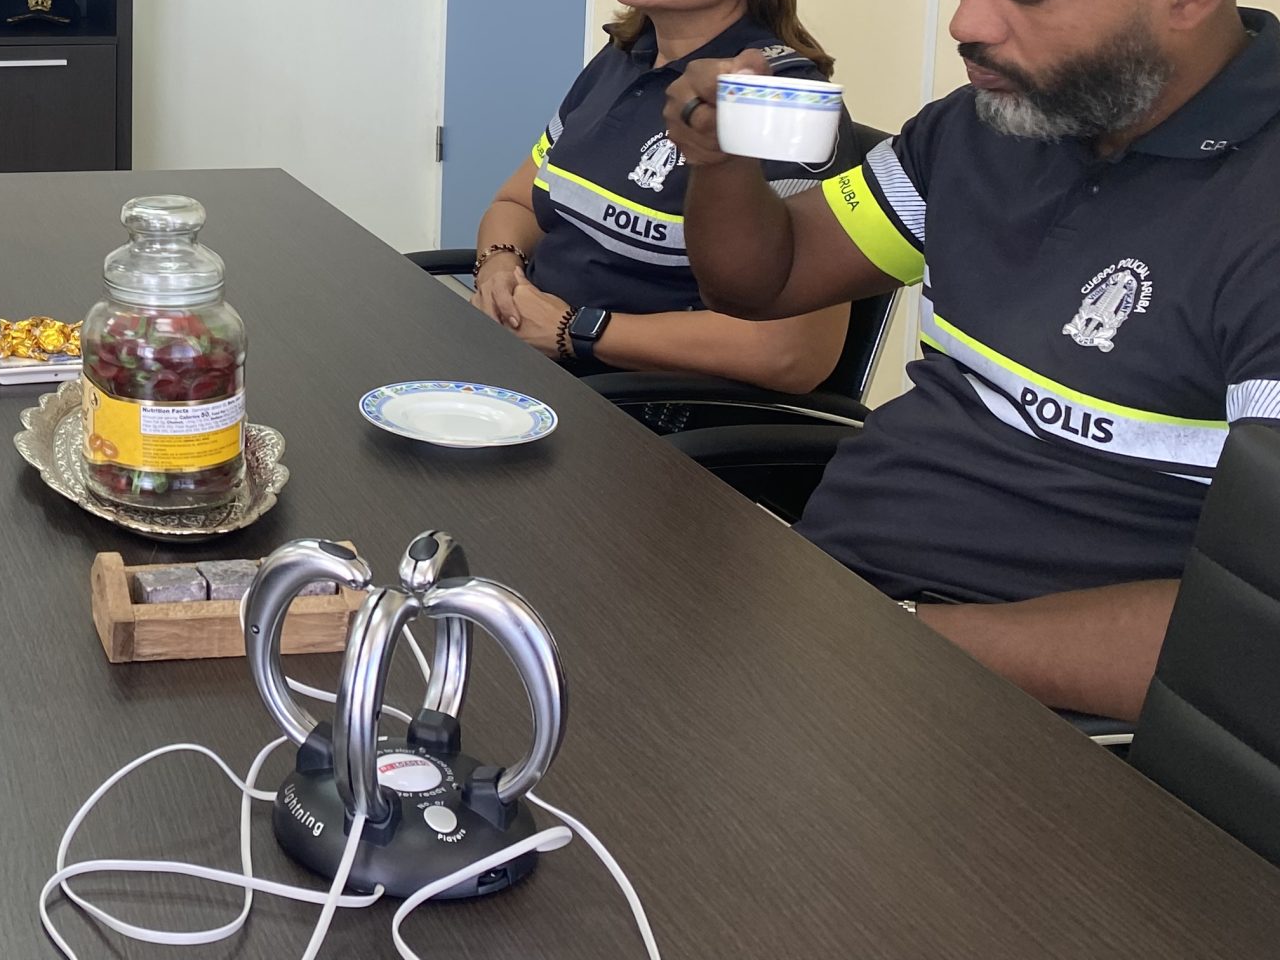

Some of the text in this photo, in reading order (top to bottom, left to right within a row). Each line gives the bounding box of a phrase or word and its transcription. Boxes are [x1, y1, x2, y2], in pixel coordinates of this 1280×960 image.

[603, 204, 668, 242] POLIS
[1080, 257, 1153, 313] CUERPO POLICIAL ARUBA
[1021, 386, 1114, 444] POLIS
[284, 783, 325, 837] Lightning
[437, 828, 467, 844] Players
